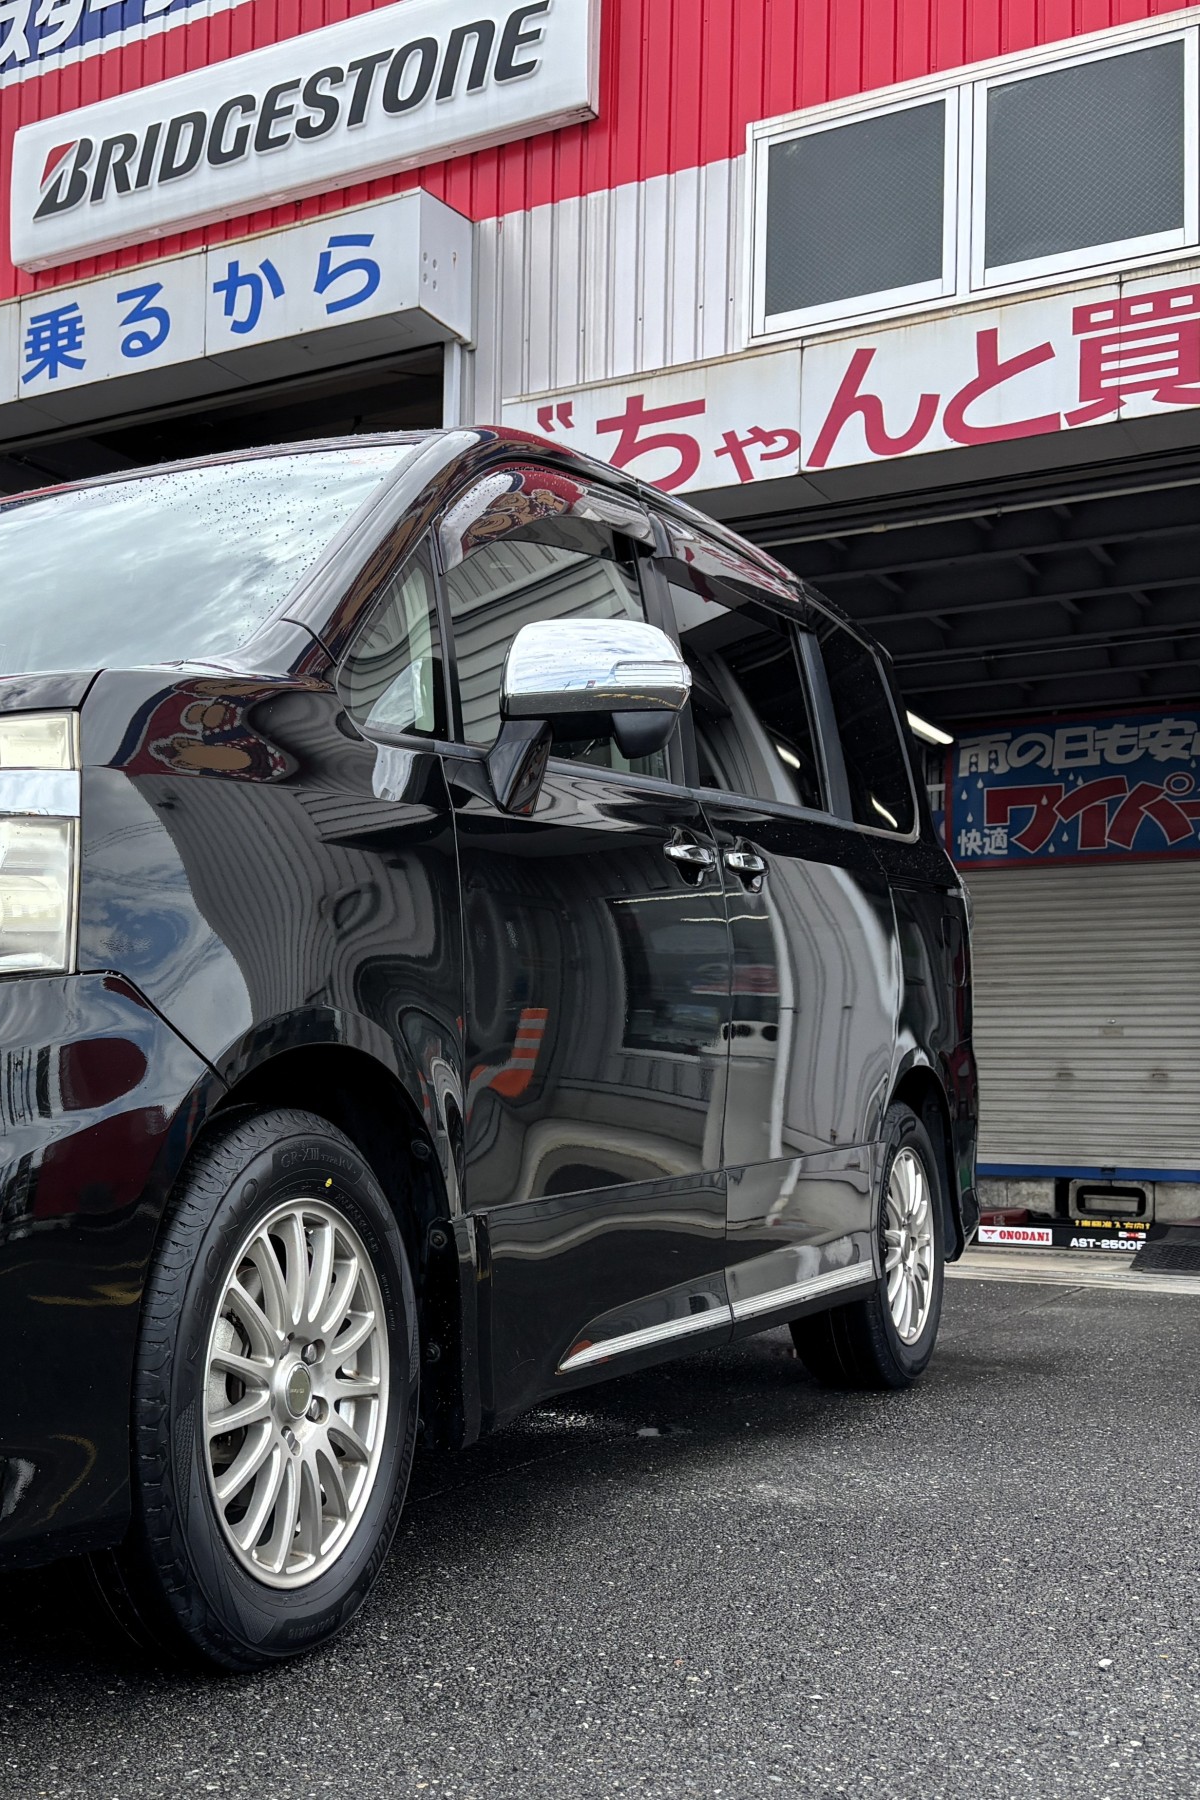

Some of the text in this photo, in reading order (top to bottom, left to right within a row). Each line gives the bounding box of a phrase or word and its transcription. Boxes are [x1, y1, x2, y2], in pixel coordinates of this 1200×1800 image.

[33, 0, 551, 220] BRIDGESTONE
[957, 717, 1200, 778] 雨の日も安
[957, 827, 1009, 857] 快適
[998, 1229, 1051, 1242] ONODANI
